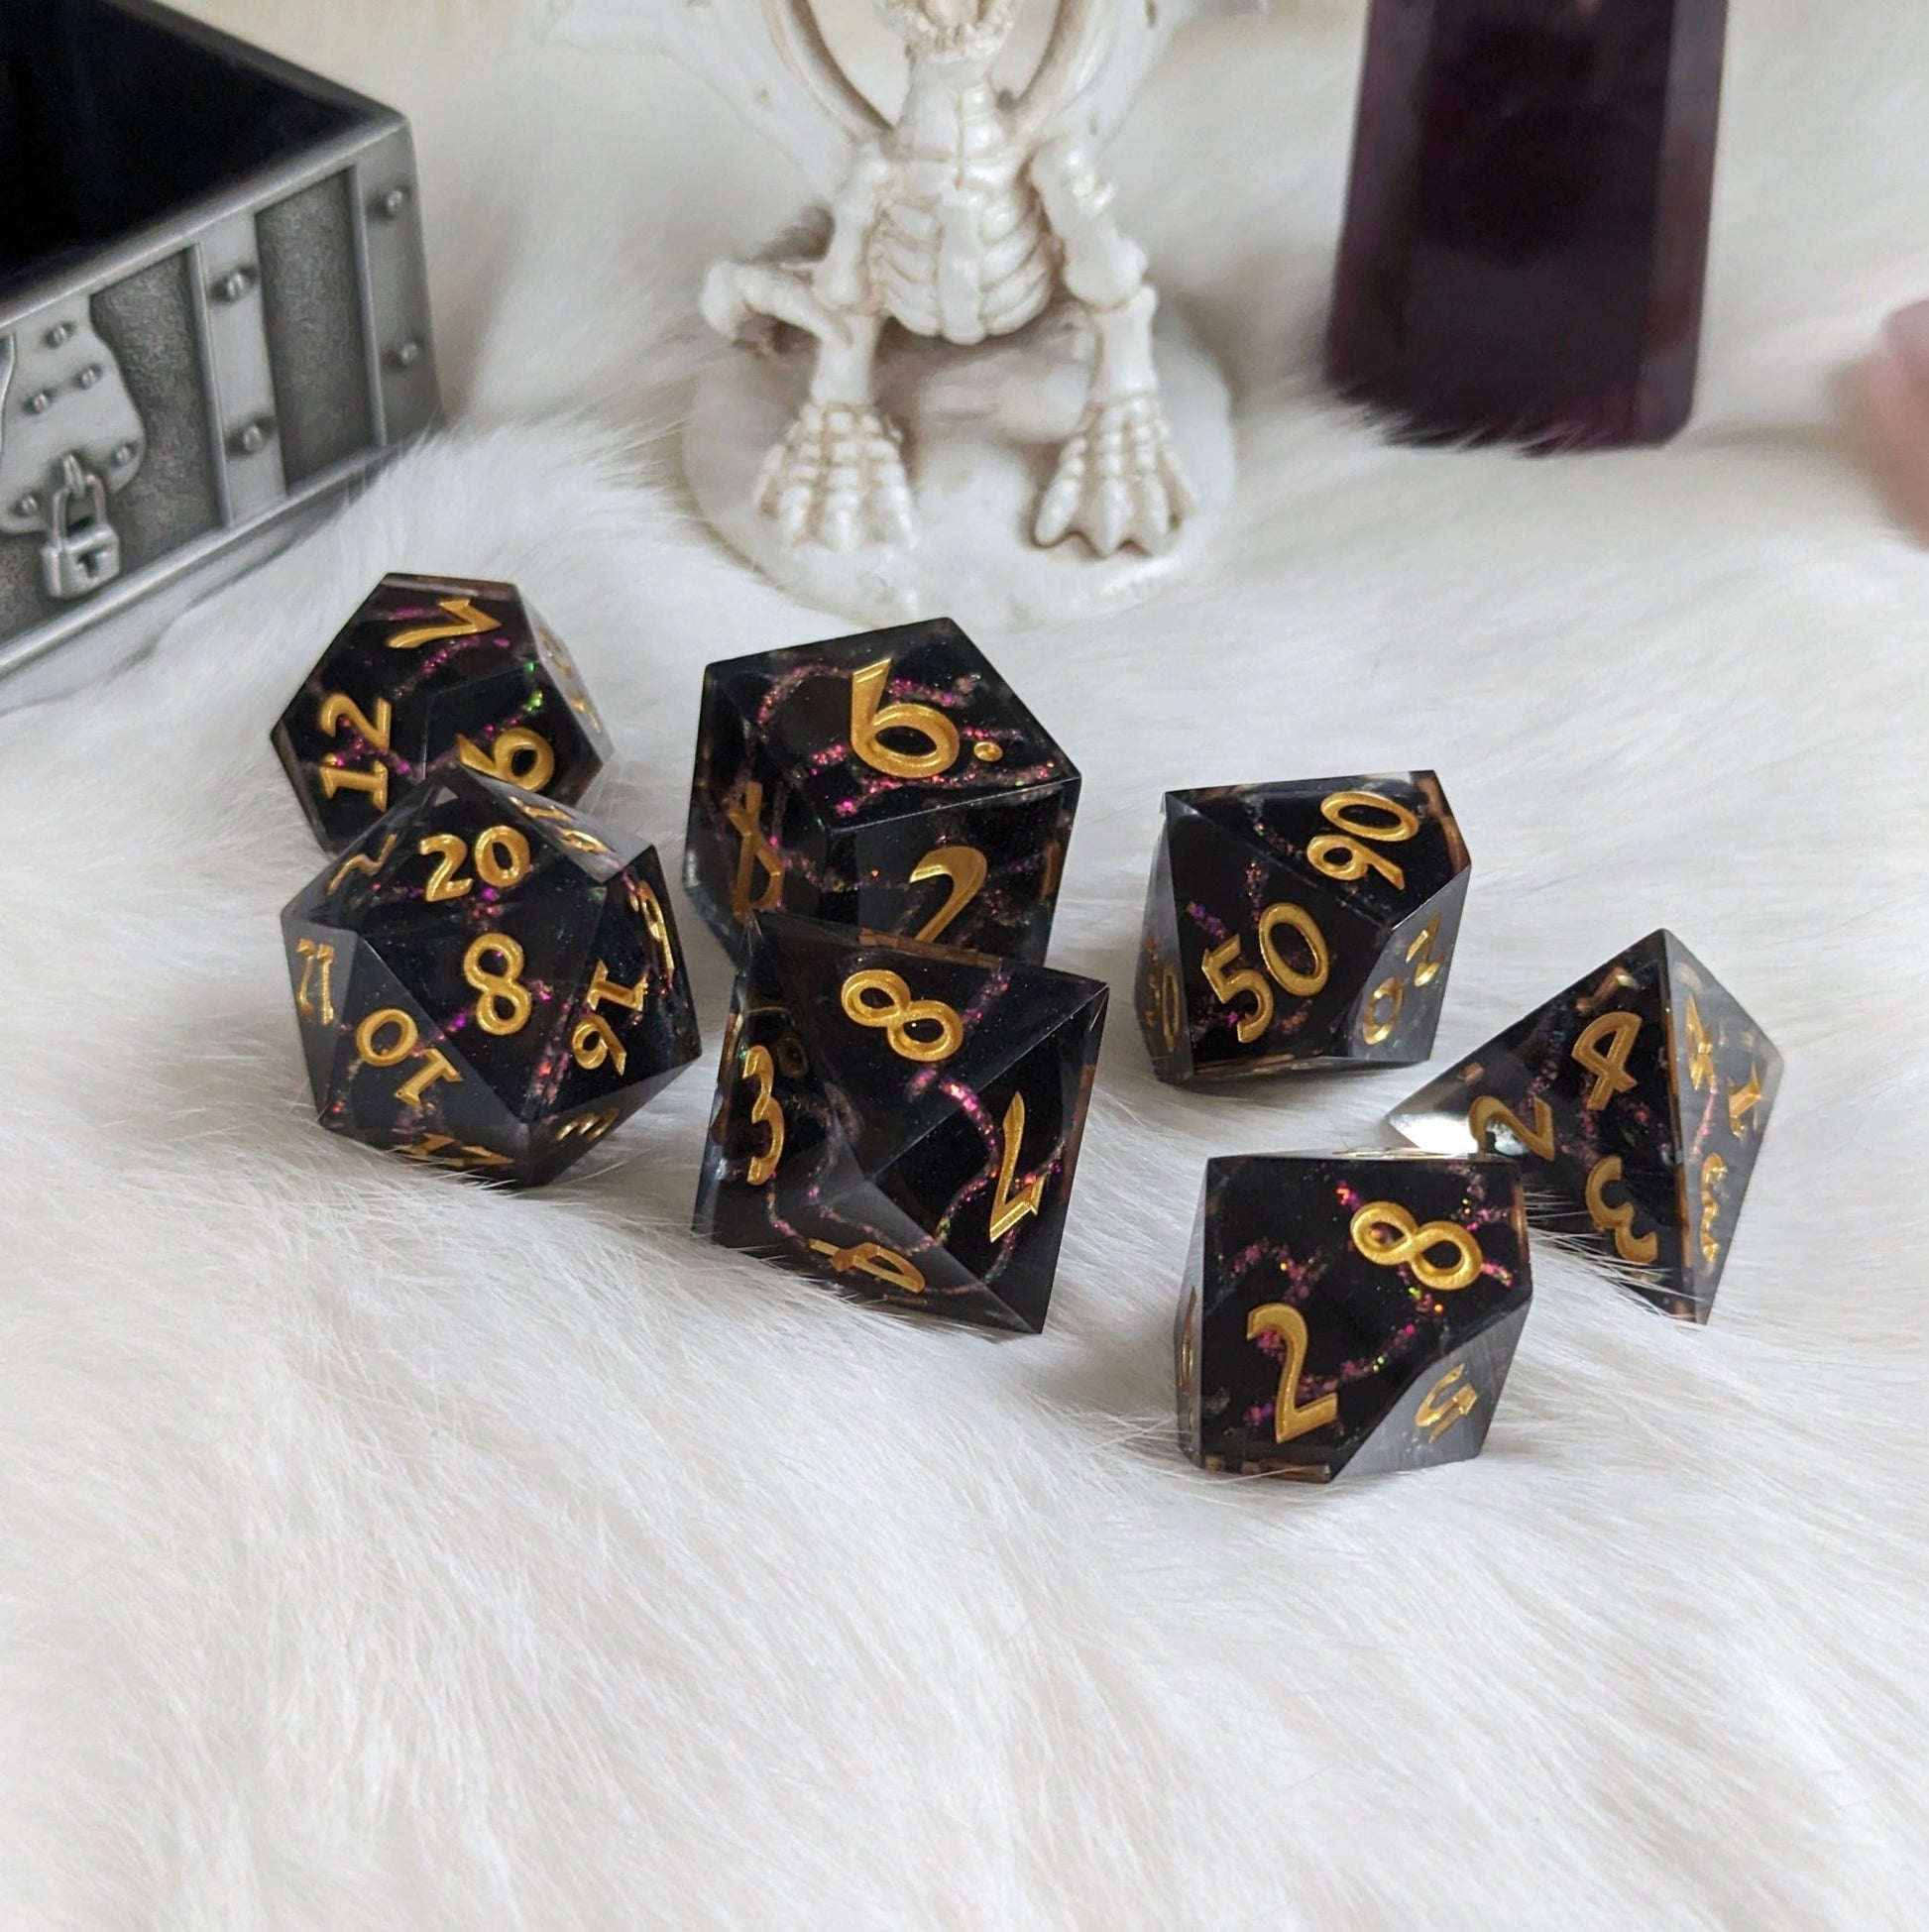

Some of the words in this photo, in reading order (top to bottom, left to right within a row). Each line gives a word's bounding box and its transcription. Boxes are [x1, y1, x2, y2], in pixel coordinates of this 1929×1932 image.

[321, 694, 393, 811] 12
[420, 825, 531, 903] 20
[1305, 791, 1420, 889] 90
[463, 932, 532, 1035] 8
[571, 959, 649, 1076] 16
[841, 969, 964, 1062] 8
[1200, 902, 1331, 1044] 50
[355, 1008, 464, 1108] 10
[1571, 1010, 1643, 1111] 4
[742, 1045, 786, 1187] 3
[1349, 1201, 1483, 1292] 8
[1585, 1156, 1658, 1266] 3
[809, 1238, 926, 1295] 4
[1246, 1303, 1338, 1444] 2
[1415, 1363, 1478, 1444] 5
